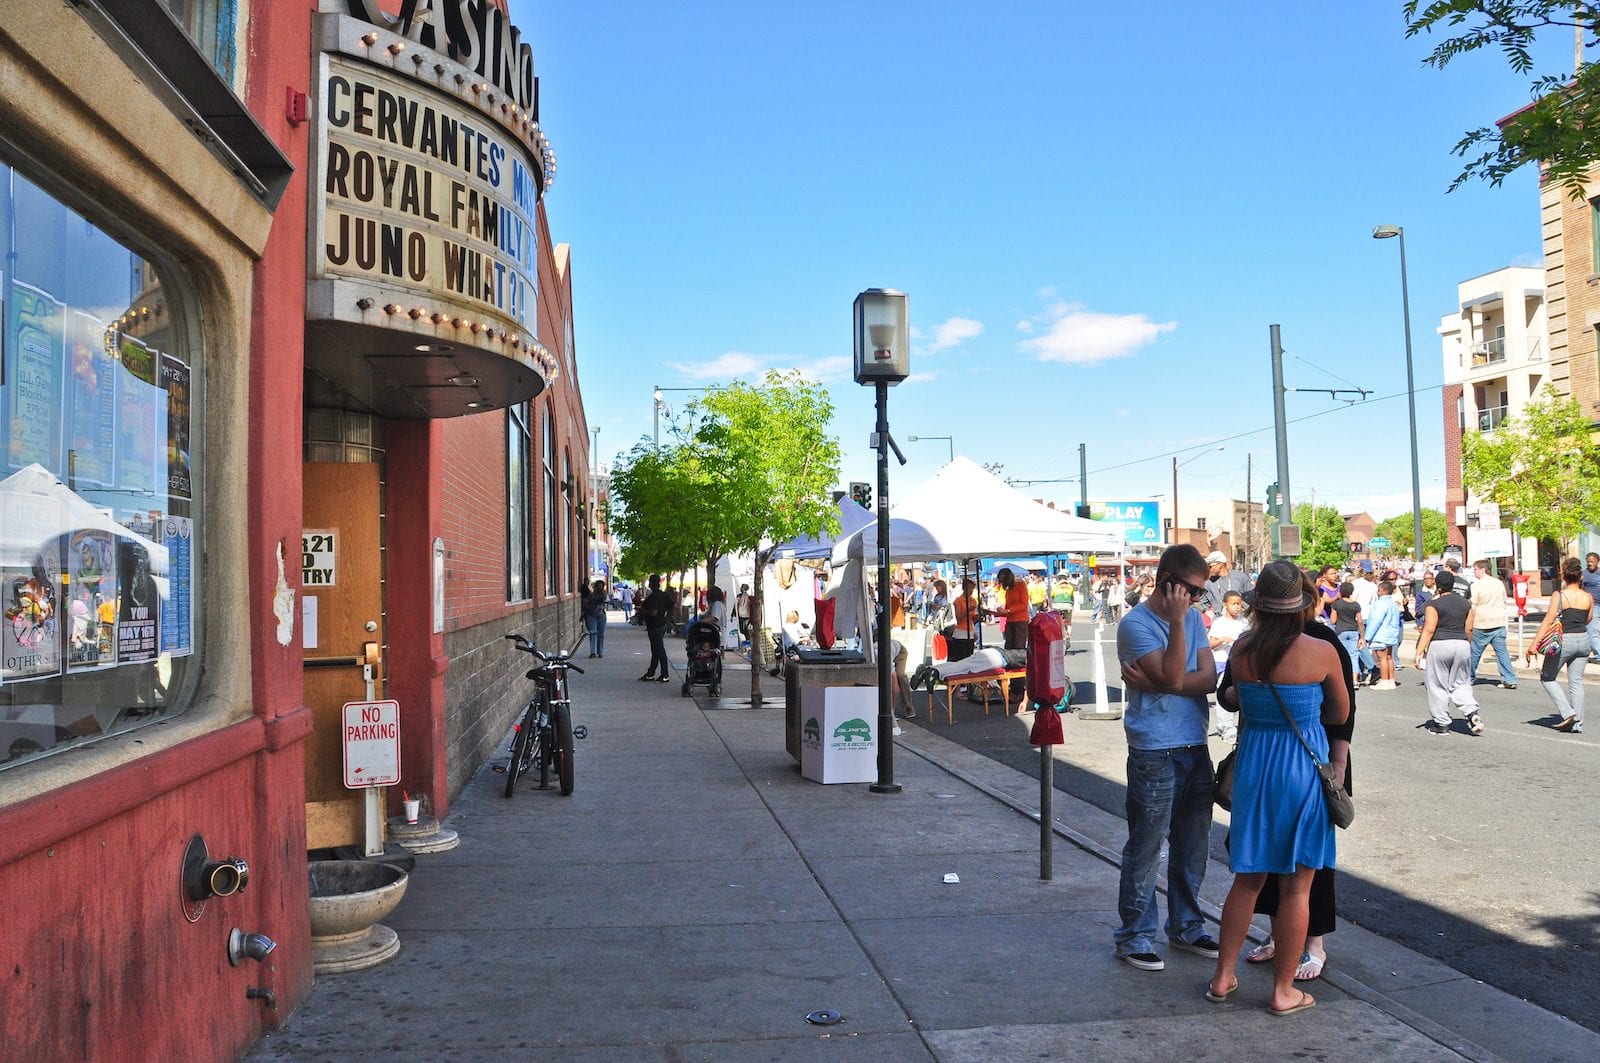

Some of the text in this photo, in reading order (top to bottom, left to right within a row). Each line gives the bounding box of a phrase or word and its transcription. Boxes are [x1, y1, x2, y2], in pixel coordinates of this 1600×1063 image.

[328, 75, 505, 188] CERVANTES'
[327, 141, 440, 222] ROYAL
[451, 180, 522, 262] FAMILY
[326, 213, 426, 282] JUNO
[1104, 506, 1144, 520] PLAY
[312, 535, 333, 552] 21
[119, 627, 140, 640] MAY
[362, 707, 381, 723] NO
[348, 723, 396, 742] PARKING
